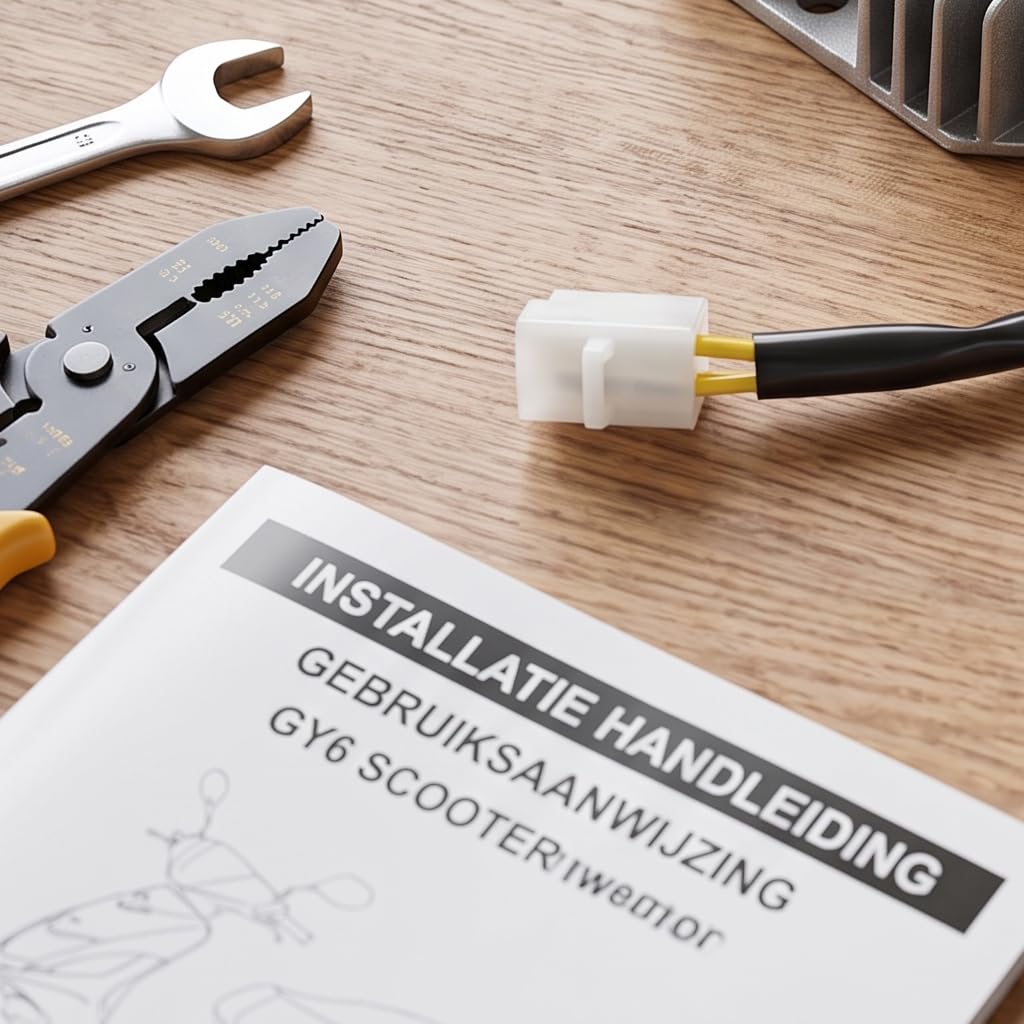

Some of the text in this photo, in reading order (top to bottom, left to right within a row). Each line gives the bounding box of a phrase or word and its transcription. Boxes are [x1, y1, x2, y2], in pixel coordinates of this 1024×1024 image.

[267, 705, 354, 764] GY6
[290, 556, 944, 899] INSTALLATIE HANDLEIDING
[296, 644, 797, 914] GEBRUIKSAANWIJZING
